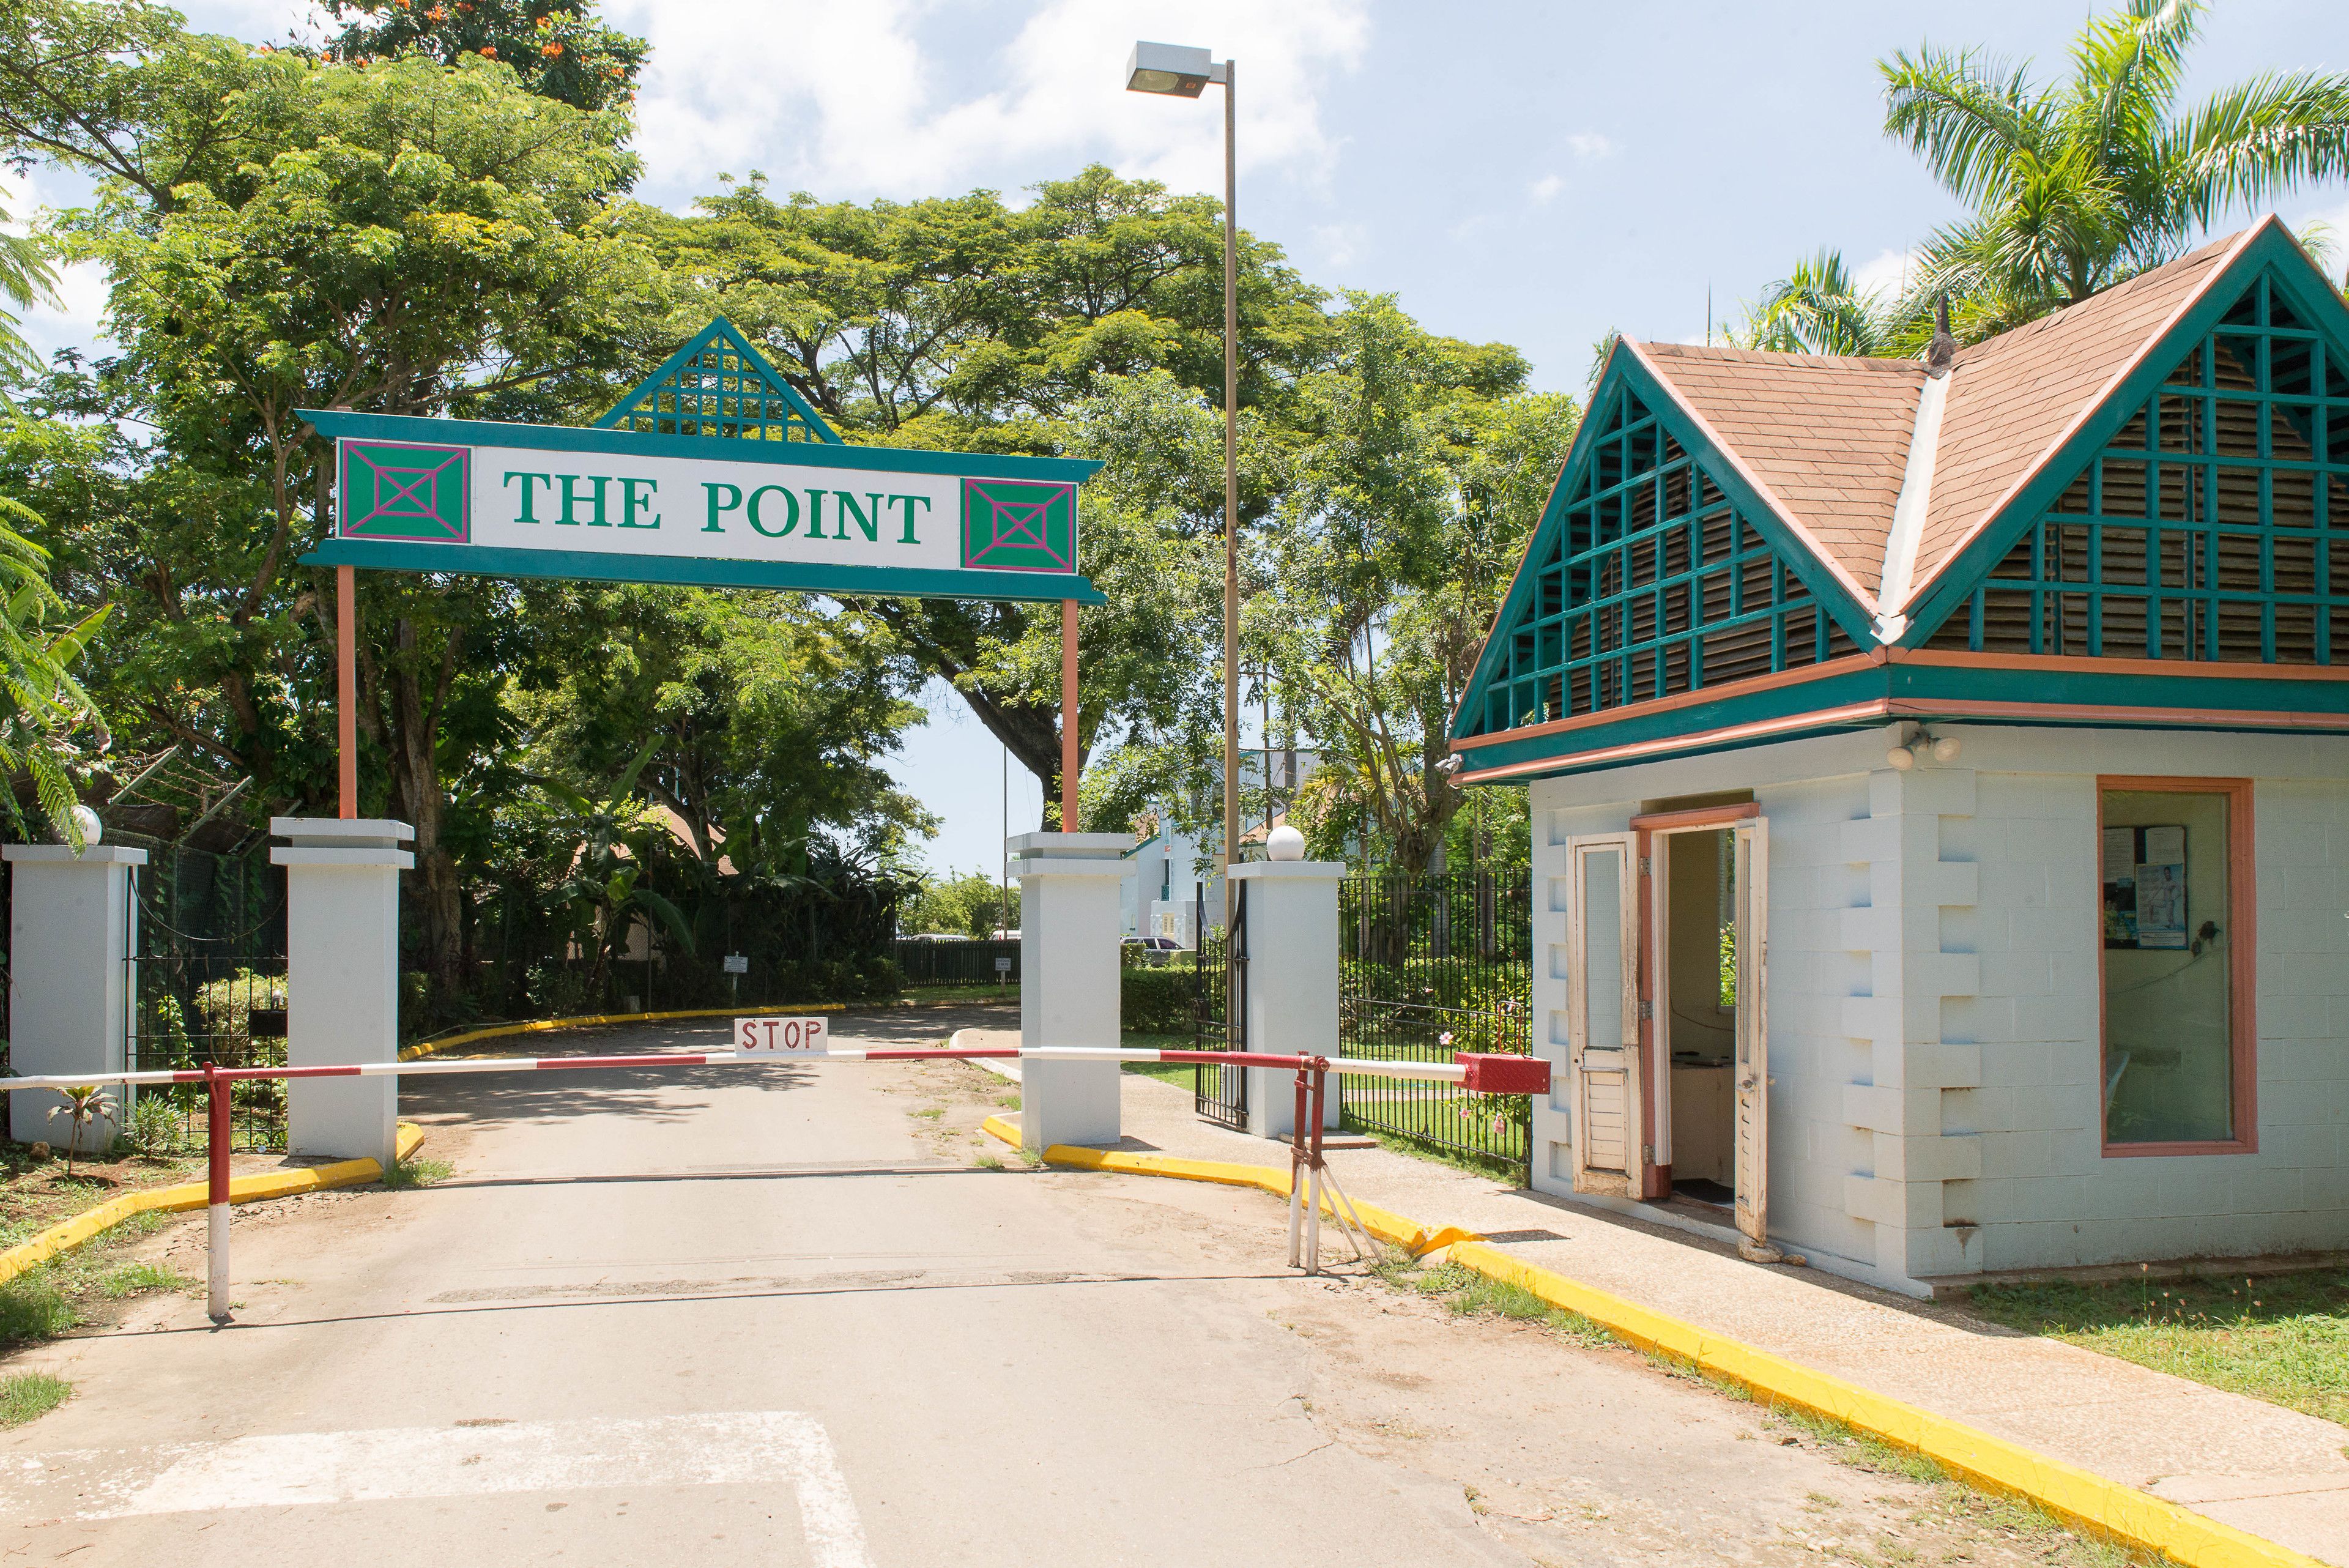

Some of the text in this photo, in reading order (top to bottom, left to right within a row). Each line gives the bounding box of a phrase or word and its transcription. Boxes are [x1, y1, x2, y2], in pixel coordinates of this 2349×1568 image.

[503, 471, 931, 544] THE POINT
[742, 1020, 822, 1049] STOP
